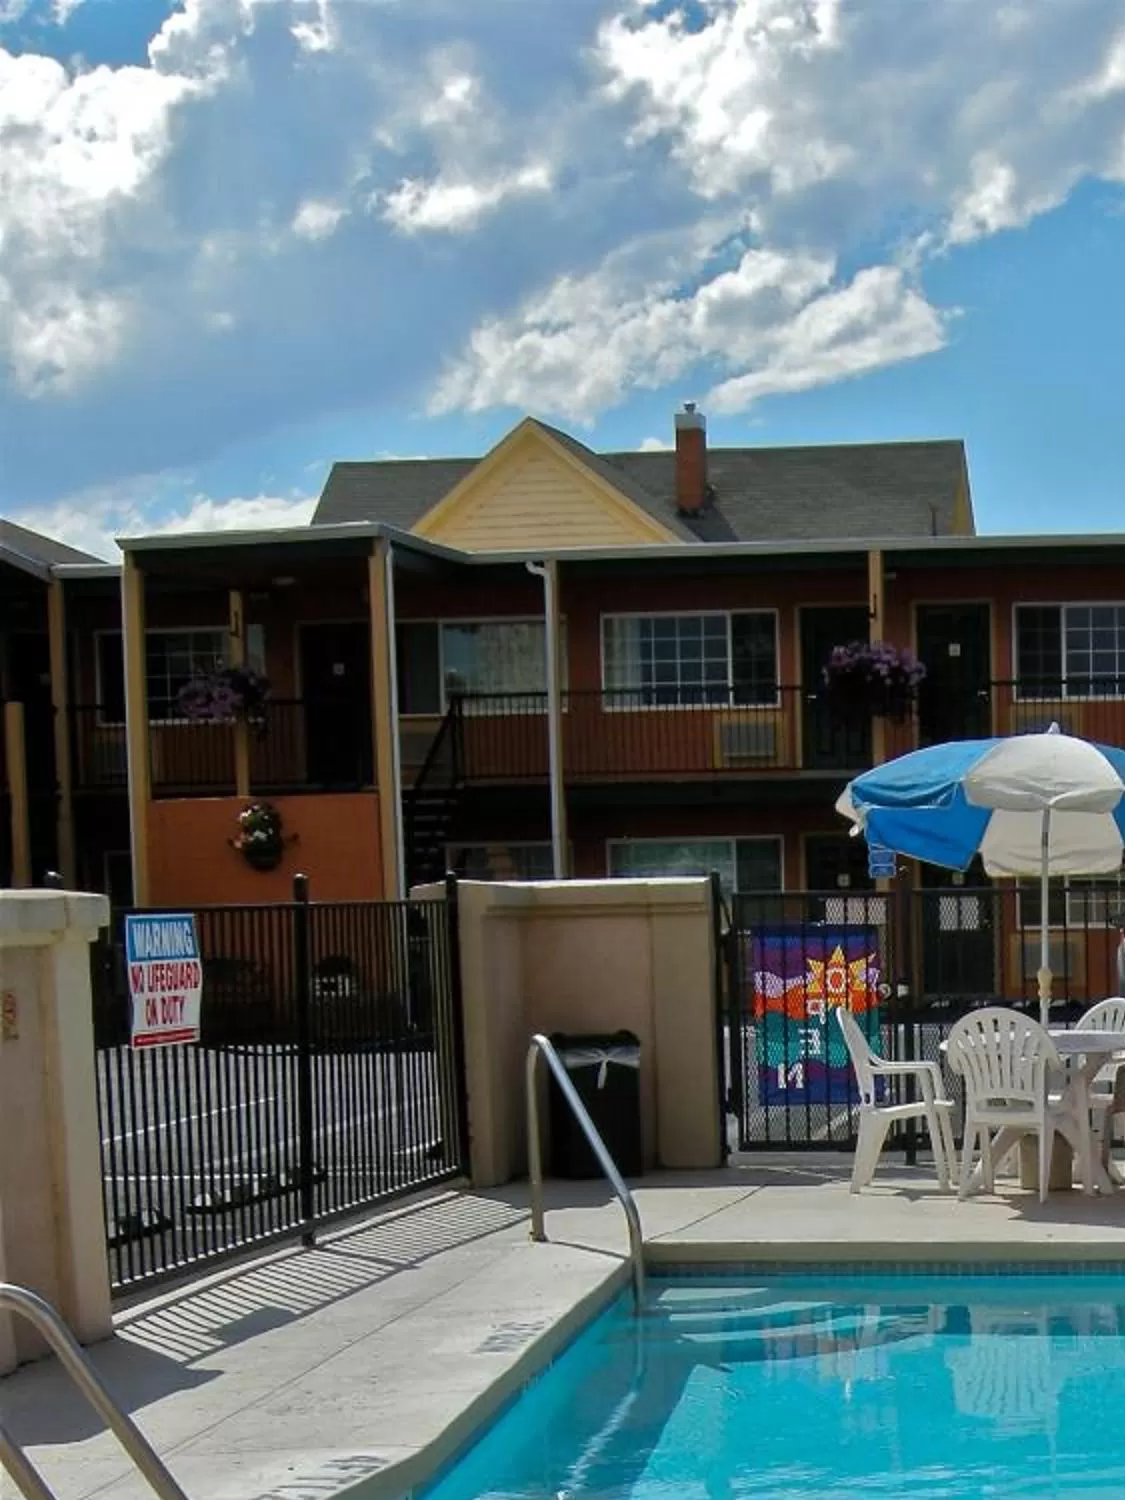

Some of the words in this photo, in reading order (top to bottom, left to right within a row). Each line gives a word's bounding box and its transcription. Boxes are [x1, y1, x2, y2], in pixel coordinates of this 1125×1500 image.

[133, 921, 194, 957] WARNING
[130, 963, 145, 993] NO
[147, 961, 201, 993] LIFEGUARD
[145, 997, 159, 1026] ON
[161, 995, 185, 1025] DUTY
